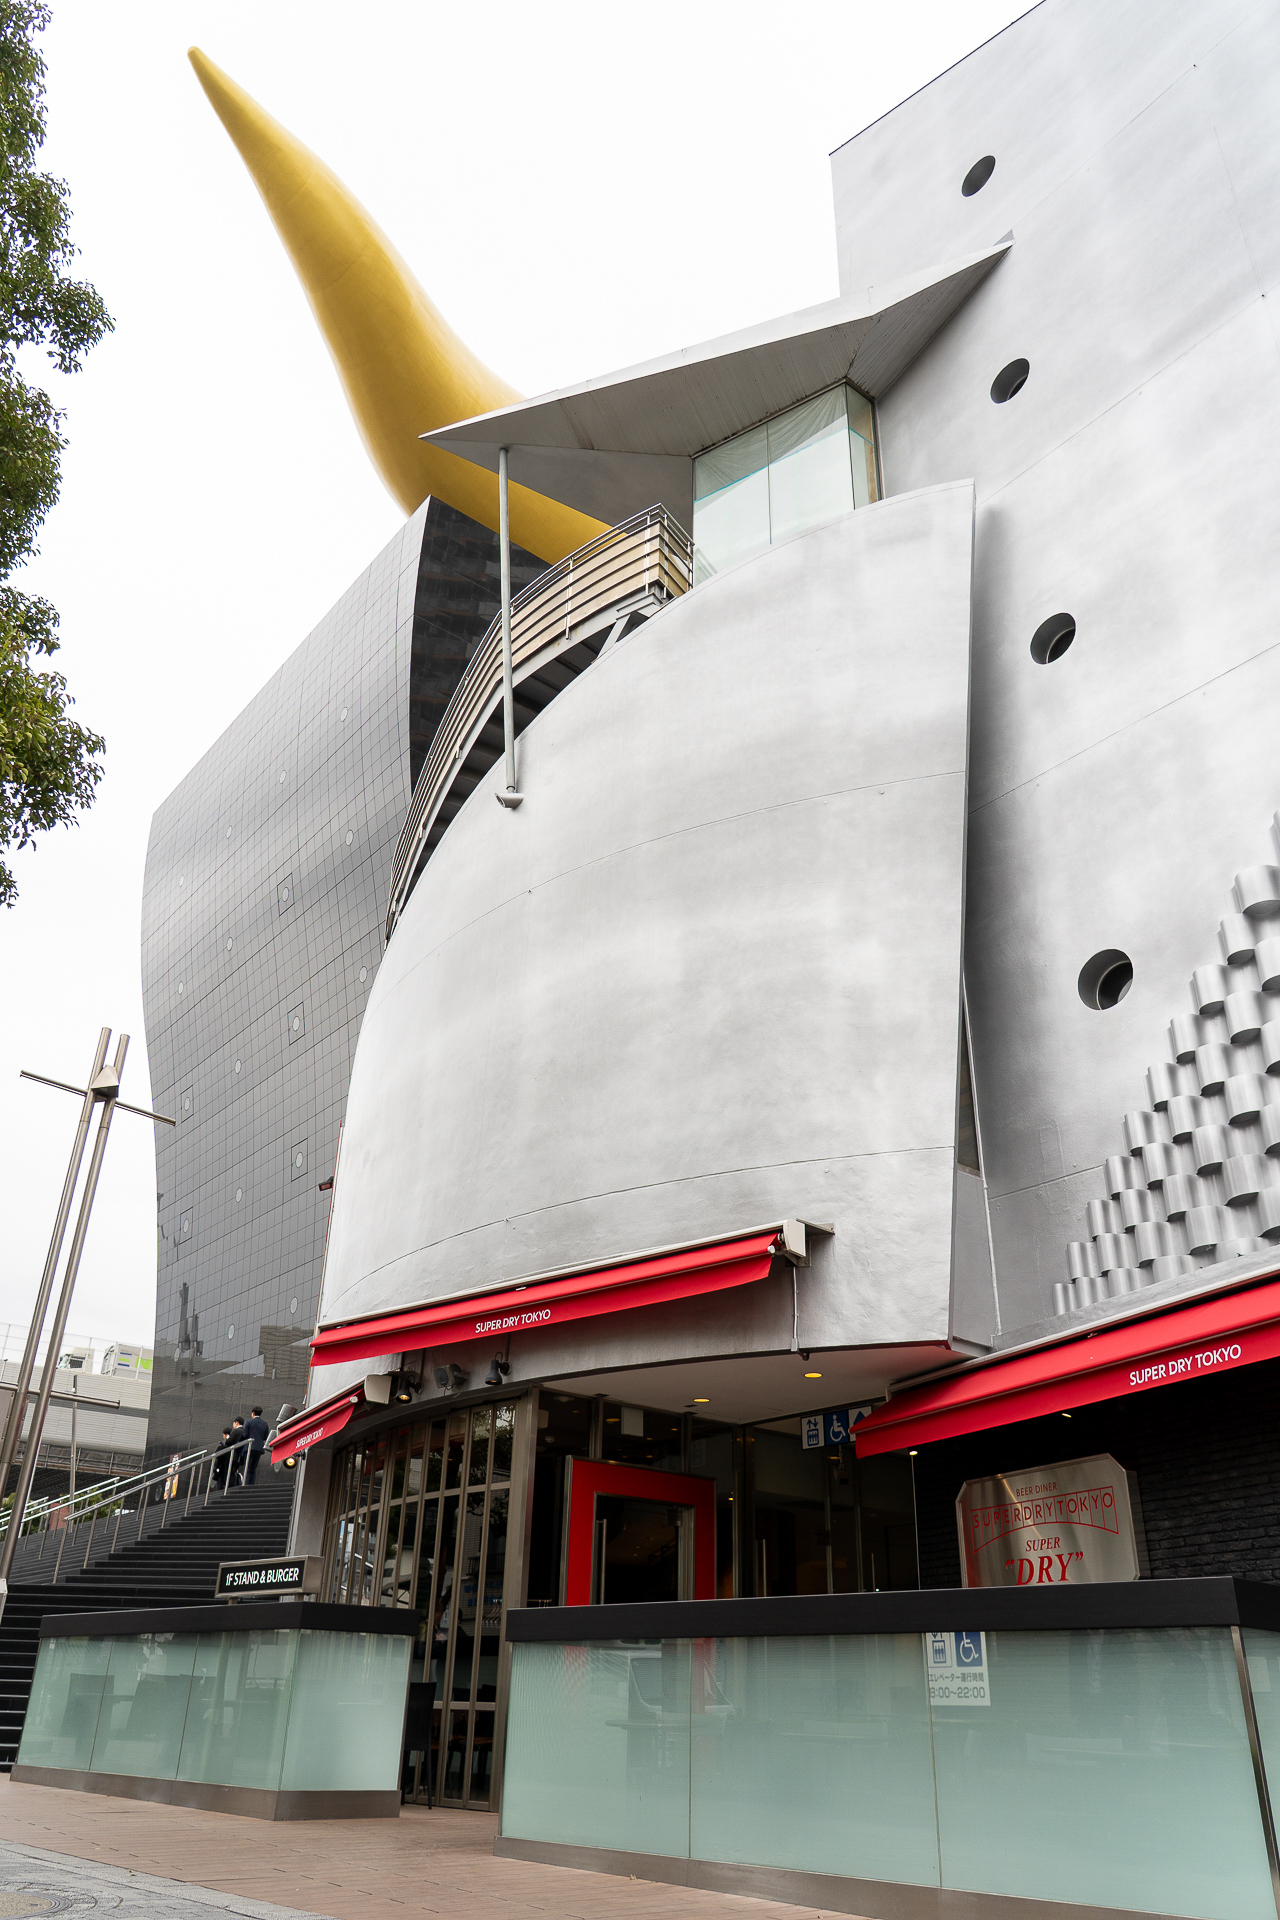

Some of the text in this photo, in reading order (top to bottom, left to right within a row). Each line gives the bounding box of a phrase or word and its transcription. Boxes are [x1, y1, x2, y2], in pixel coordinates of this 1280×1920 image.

[475, 1309, 551, 1333] SUPER DRY TOKYO
[1129, 1344, 1241, 1386] SUPER DRY TOKYO
[1016, 1481, 1057, 1497] BEER DINER
[1025, 1536, 1061, 1553] SUPER
[233, 1570, 259, 1586] STAND
[259, 1570, 265, 1584] &
[266, 1567, 299, 1583] BURGER
